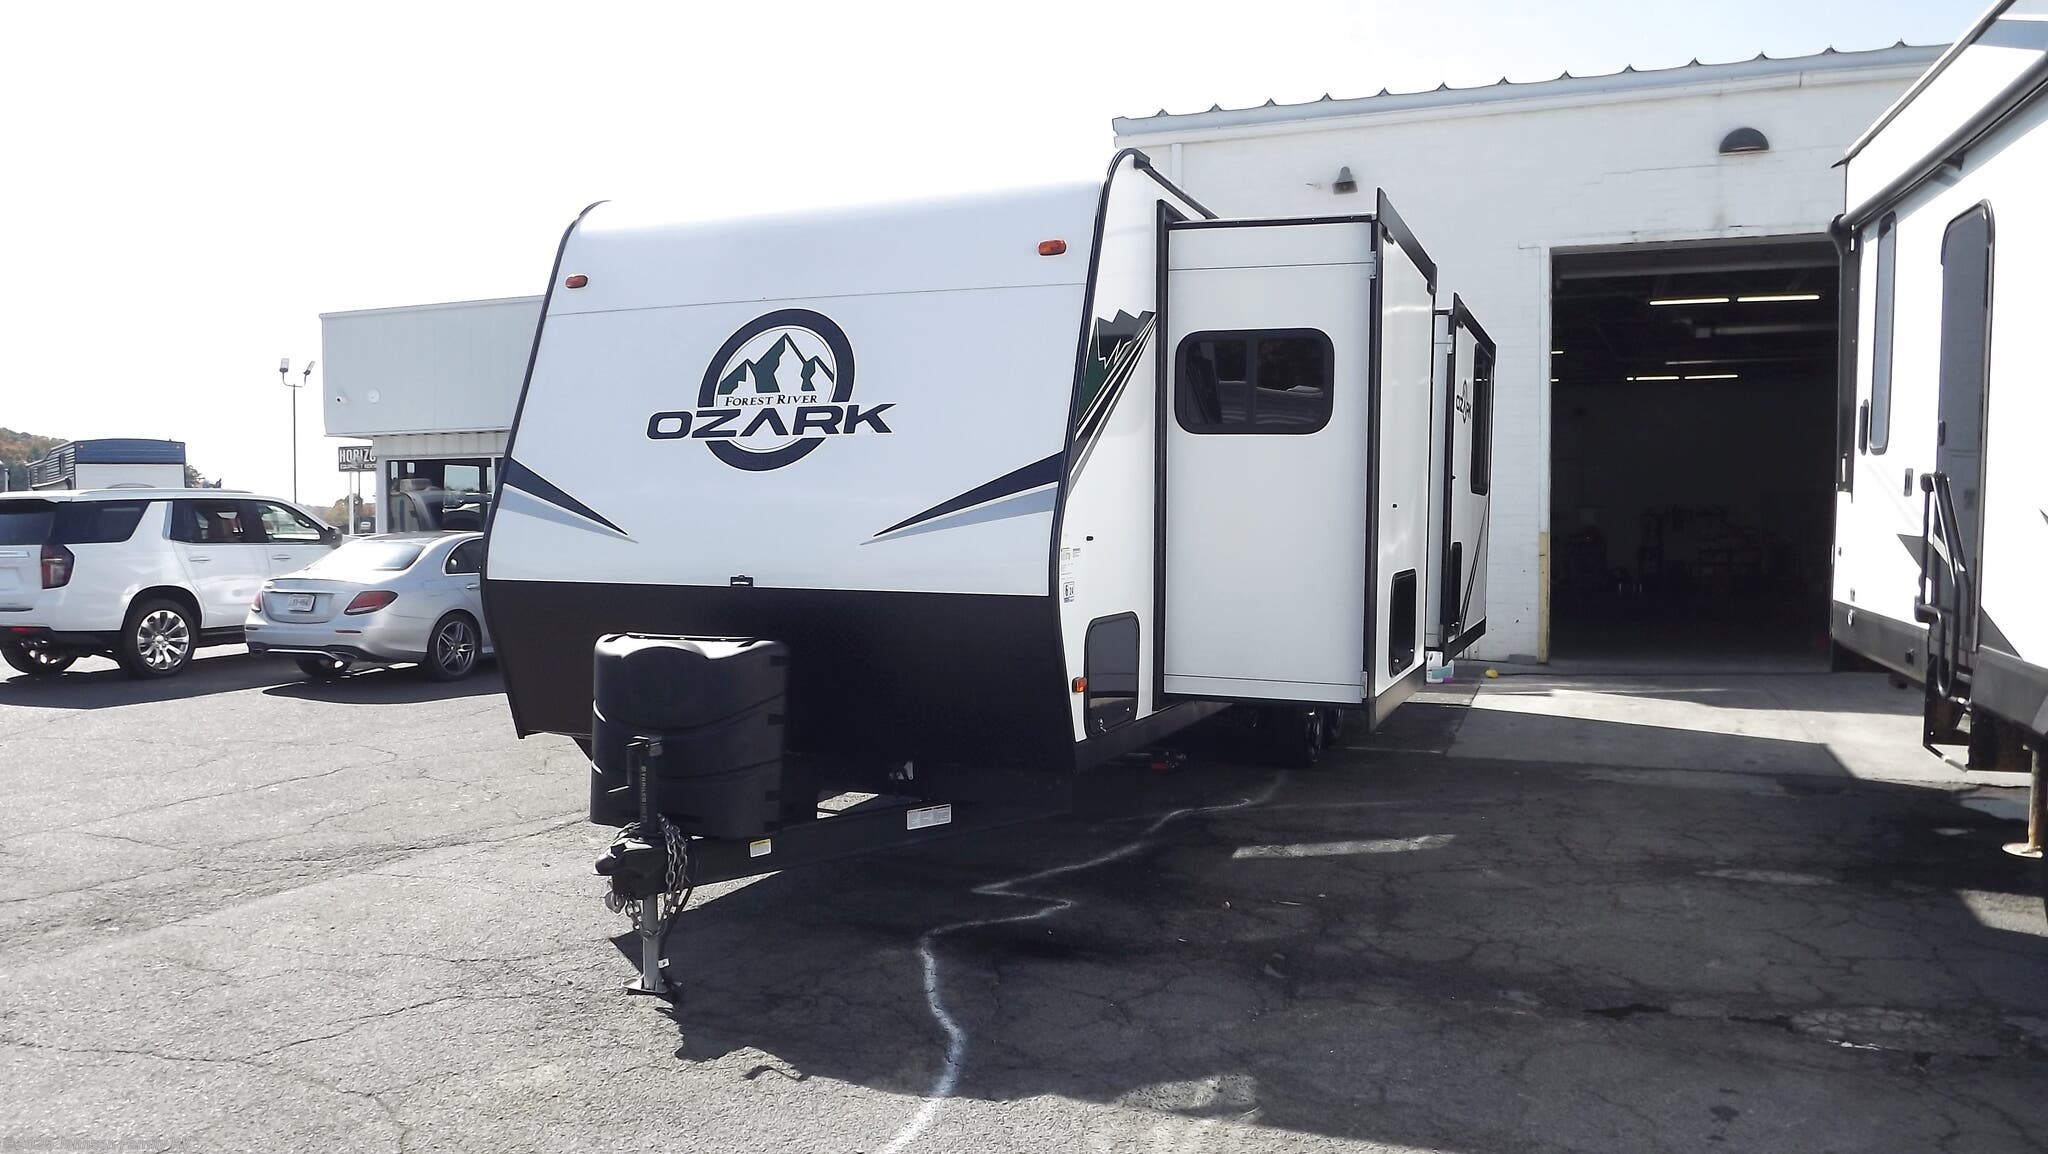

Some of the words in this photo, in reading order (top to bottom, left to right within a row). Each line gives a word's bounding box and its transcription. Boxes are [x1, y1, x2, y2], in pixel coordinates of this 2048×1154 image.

[725, 396, 774, 407] FOREST
[777, 394, 818, 405] RIVER
[646, 403, 897, 440] OZARK
